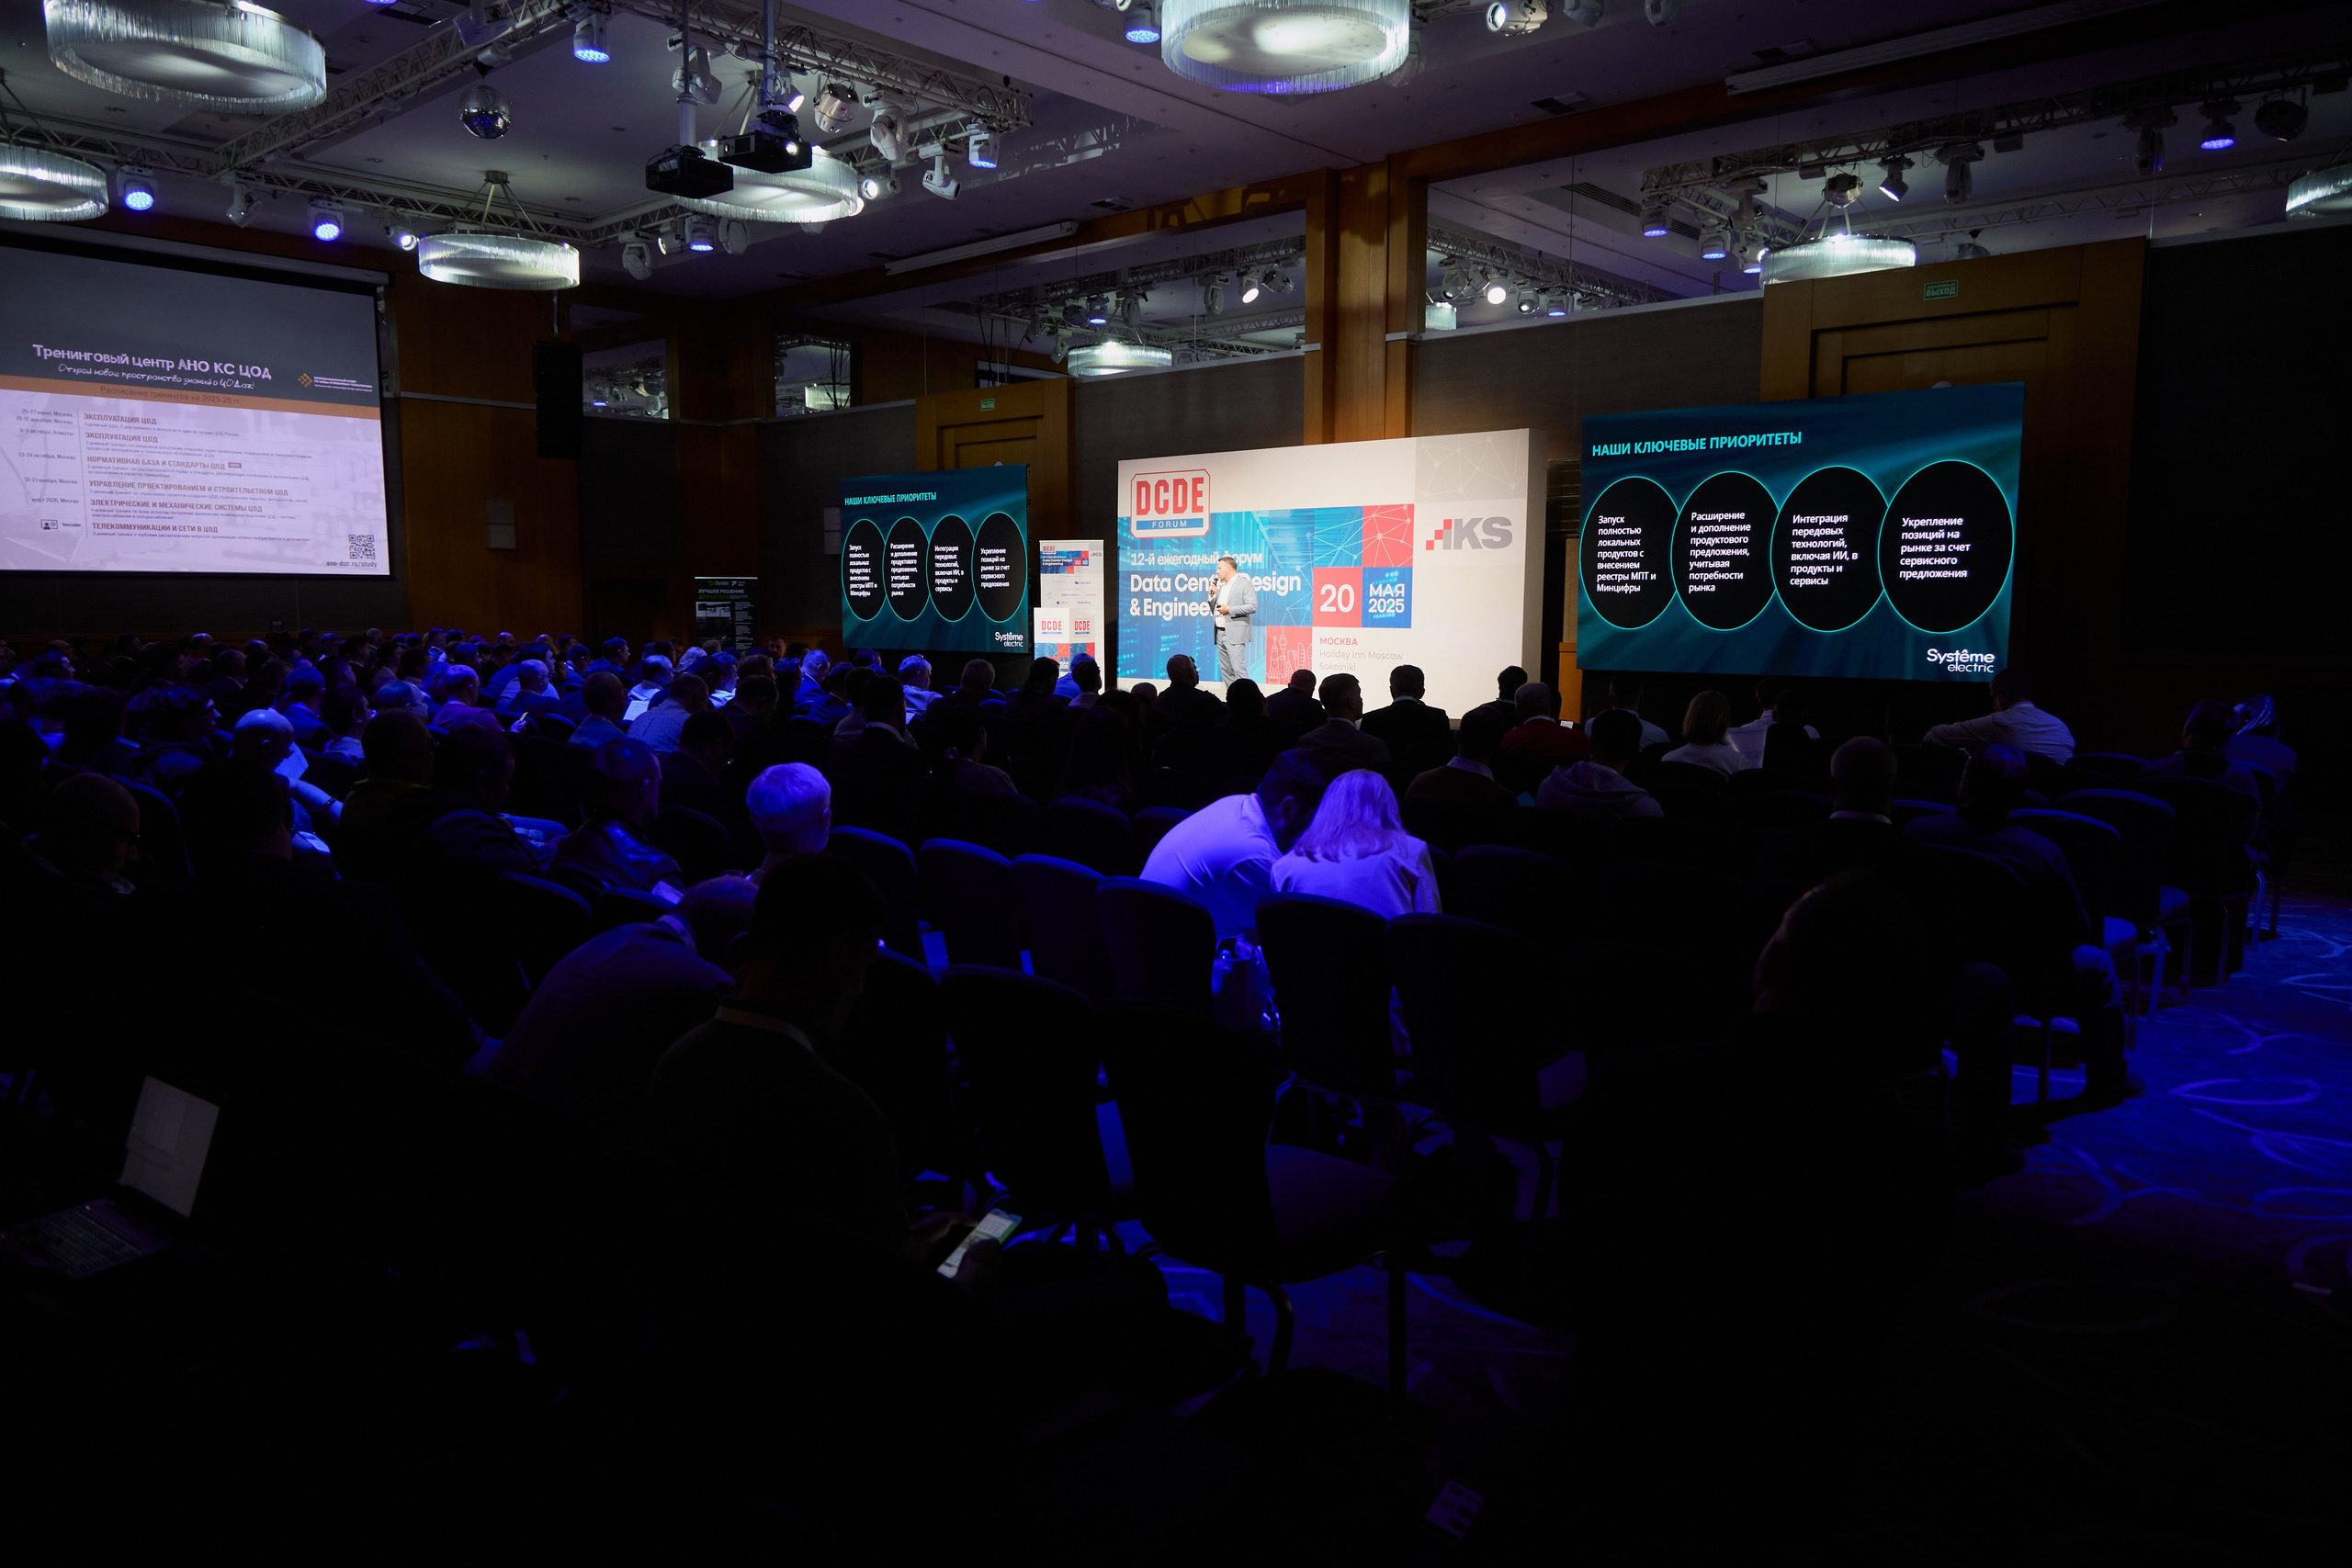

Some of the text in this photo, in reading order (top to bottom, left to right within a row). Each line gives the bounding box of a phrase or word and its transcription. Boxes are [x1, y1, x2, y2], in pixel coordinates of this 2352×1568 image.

[1926, 287, 1955, 297] ВЫХОД
[32, 344, 272, 379] Тренинговый центр АНО КС ЦОД
[58, 363, 92, 376] Открой
[94, 368, 119, 377] новое
[121, 371, 182, 382] пространство
[184, 378, 212, 386] знаний
[101, 386, 148, 396] Расписание
[150, 391, 189, 401] тренингов
[202, 395, 232, 404] 2025-26
[84, 413, 157, 425] ЭКСПЛУАТАЦИЯ ЦОД
[85, 432, 141, 442] ЭКСПЛУАТАЦИЯ
[1592, 432, 1802, 457] НАШИ КЛЮЧЕВЫЕ ПРИОРИТЕТЫ
[87, 456, 141, 465] НОРМАТИВНАЯ
[167, 460, 209, 468] СТАНДАРТЫ
[210, 462, 226, 470] ЦОД
[89, 480, 136, 489] УПРАВЛЕНИЕ
[137, 482, 206, 492] ПРОЕКТИРОВАНИЕМ
[213, 487, 274, 495] СТРОИТЕЛЬСТВОМ
[844, 491, 937, 506] НАШИ КЛЮЧЕВЫЕ ПРИОРИТЕТЫ
[1136, 477, 1204, 516] DCDE
[90, 499, 150, 508] ЭЛЕКТРИЧЕСКИЕ
[158, 502, 213, 511] МЕХАНИЧЕСКИЕ
[1598, 515, 1625, 526] Запуск
[1691, 512, 1746, 523] Расширение
[1792, 514, 1849, 525] Интеграция
[92, 523, 171, 532] ТЕЛЕКОММУНИКАЦИИ
[1151, 520, 1188, 529] FORUM
[1901, 517, 1963, 530] Укрепление
[1598, 527, 1642, 536] полностью
[1690, 525, 1751, 534] и дополнение
[1792, 527, 1844, 539] передовых
[1901, 529, 1961, 541] позиций на
[1598, 538, 1641, 547] локальных
[1690, 536, 1749, 547] продуктового
[1792, 538, 1848, 549] технологий,
[1598, 550, 1638, 559] продуктов
[1690, 547, 1750, 558] предложения,
[1900, 543, 1972, 556] рынке за счет
[1131, 551, 1156, 566] 12-й
[1157, 551, 1219, 567] ежегодный
[1791, 550, 1859, 561] включая ИИ, в
[1689, 560, 1730, 570] учитывая
[1899, 557, 1958, 568] сервисного
[1790, 564, 1843, 576] продукты и
[1899, 570, 1968, 581] предложения
[1597, 573, 1630, 583] реестры
[1631, 572, 1649, 581] МПТ
[1689, 571, 1744, 582] потребности
[1130, 570, 1302, 597] Data Cent esign
[1790, 578, 1829, 587] сервисы
[1369, 583, 1406, 598] МАЯ
[1596, 583, 1641, 594] Минцифры
[1688, 584, 1715, 594] рынка
[1319, 583, 1355, 613] 20
[1129, 596, 1214, 621] & Enginee
[1368, 598, 1405, 614] 2025
[1041, 620, 1062, 631] DCDE
[1074, 620, 1090, 631] DCDE
[995, 631, 1023, 642] Système
[1319, 637, 1358, 646] МОСКВА
[1319, 649, 1404, 660] Holiday Inn Moscow
[1927, 649, 1996, 664] Système
[1318, 661, 1357, 671] Sokolniki
[1947, 660, 1995, 673] electric
